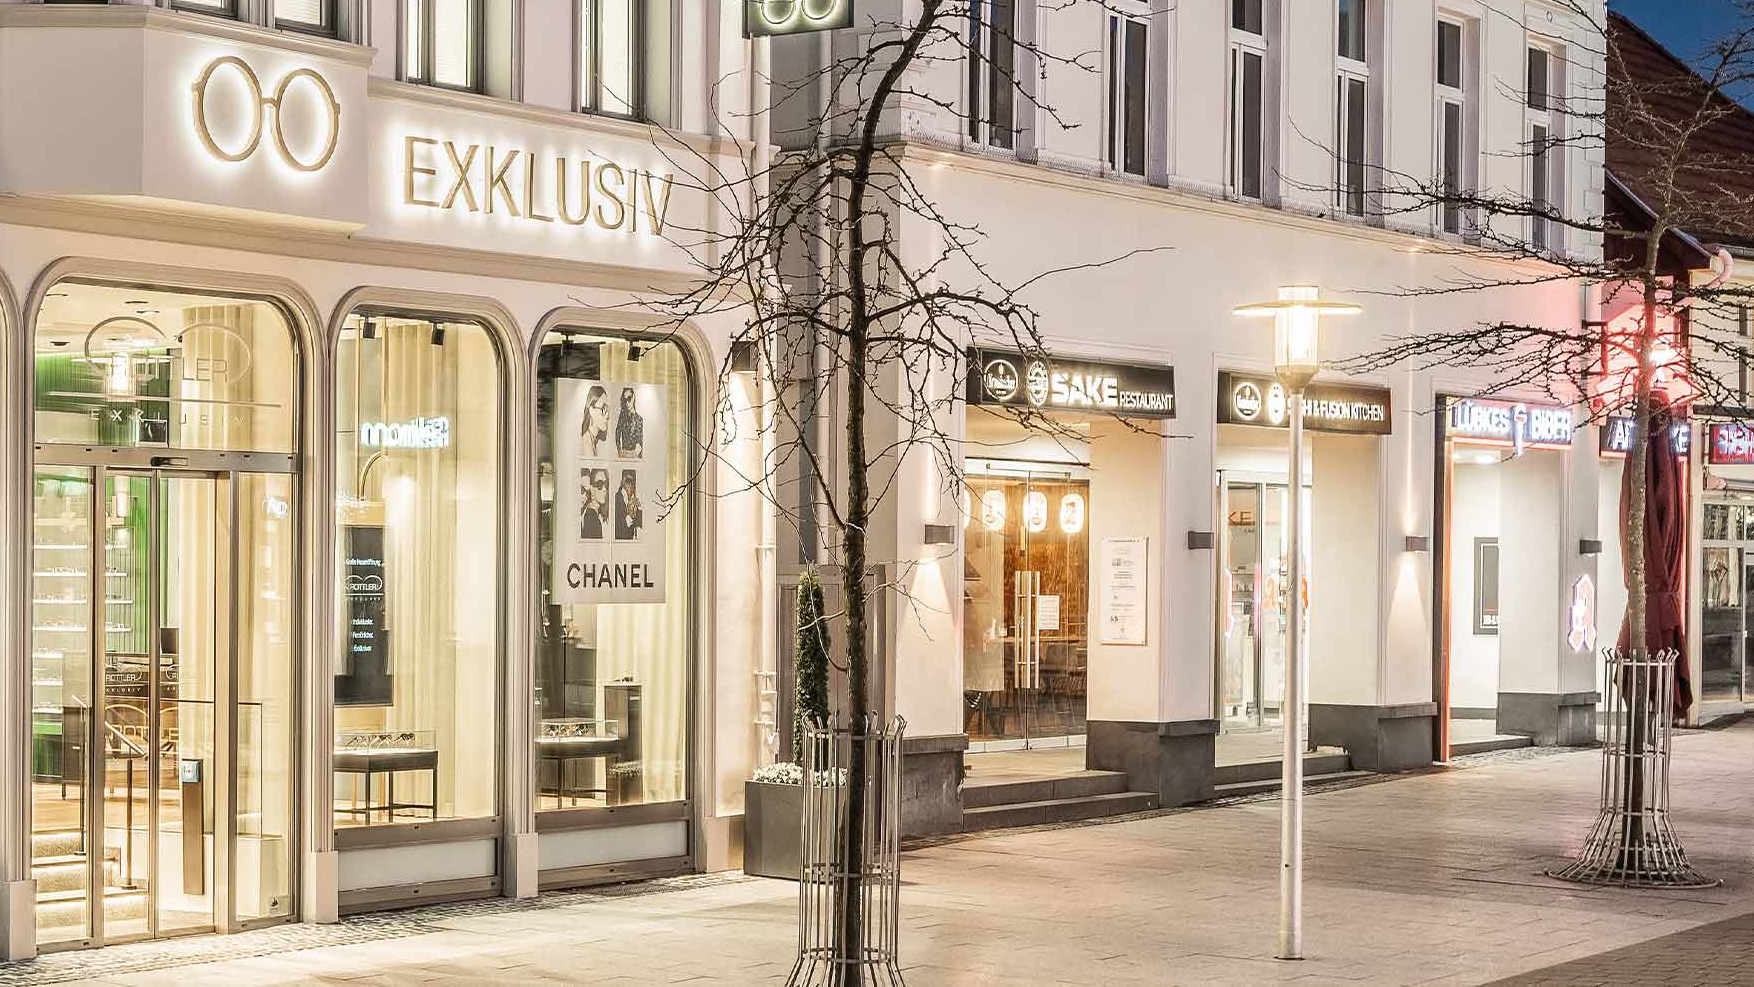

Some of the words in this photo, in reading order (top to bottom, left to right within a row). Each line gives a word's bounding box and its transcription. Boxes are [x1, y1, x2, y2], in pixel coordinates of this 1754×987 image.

[404, 135, 675, 236] EXKLUSIV
[1051, 373, 1119, 408] SAKE
[1119, 391, 1175, 410] RESTAURANT
[1351, 402, 1384, 422] KITCHEN
[566, 563, 655, 589] CHANEL
